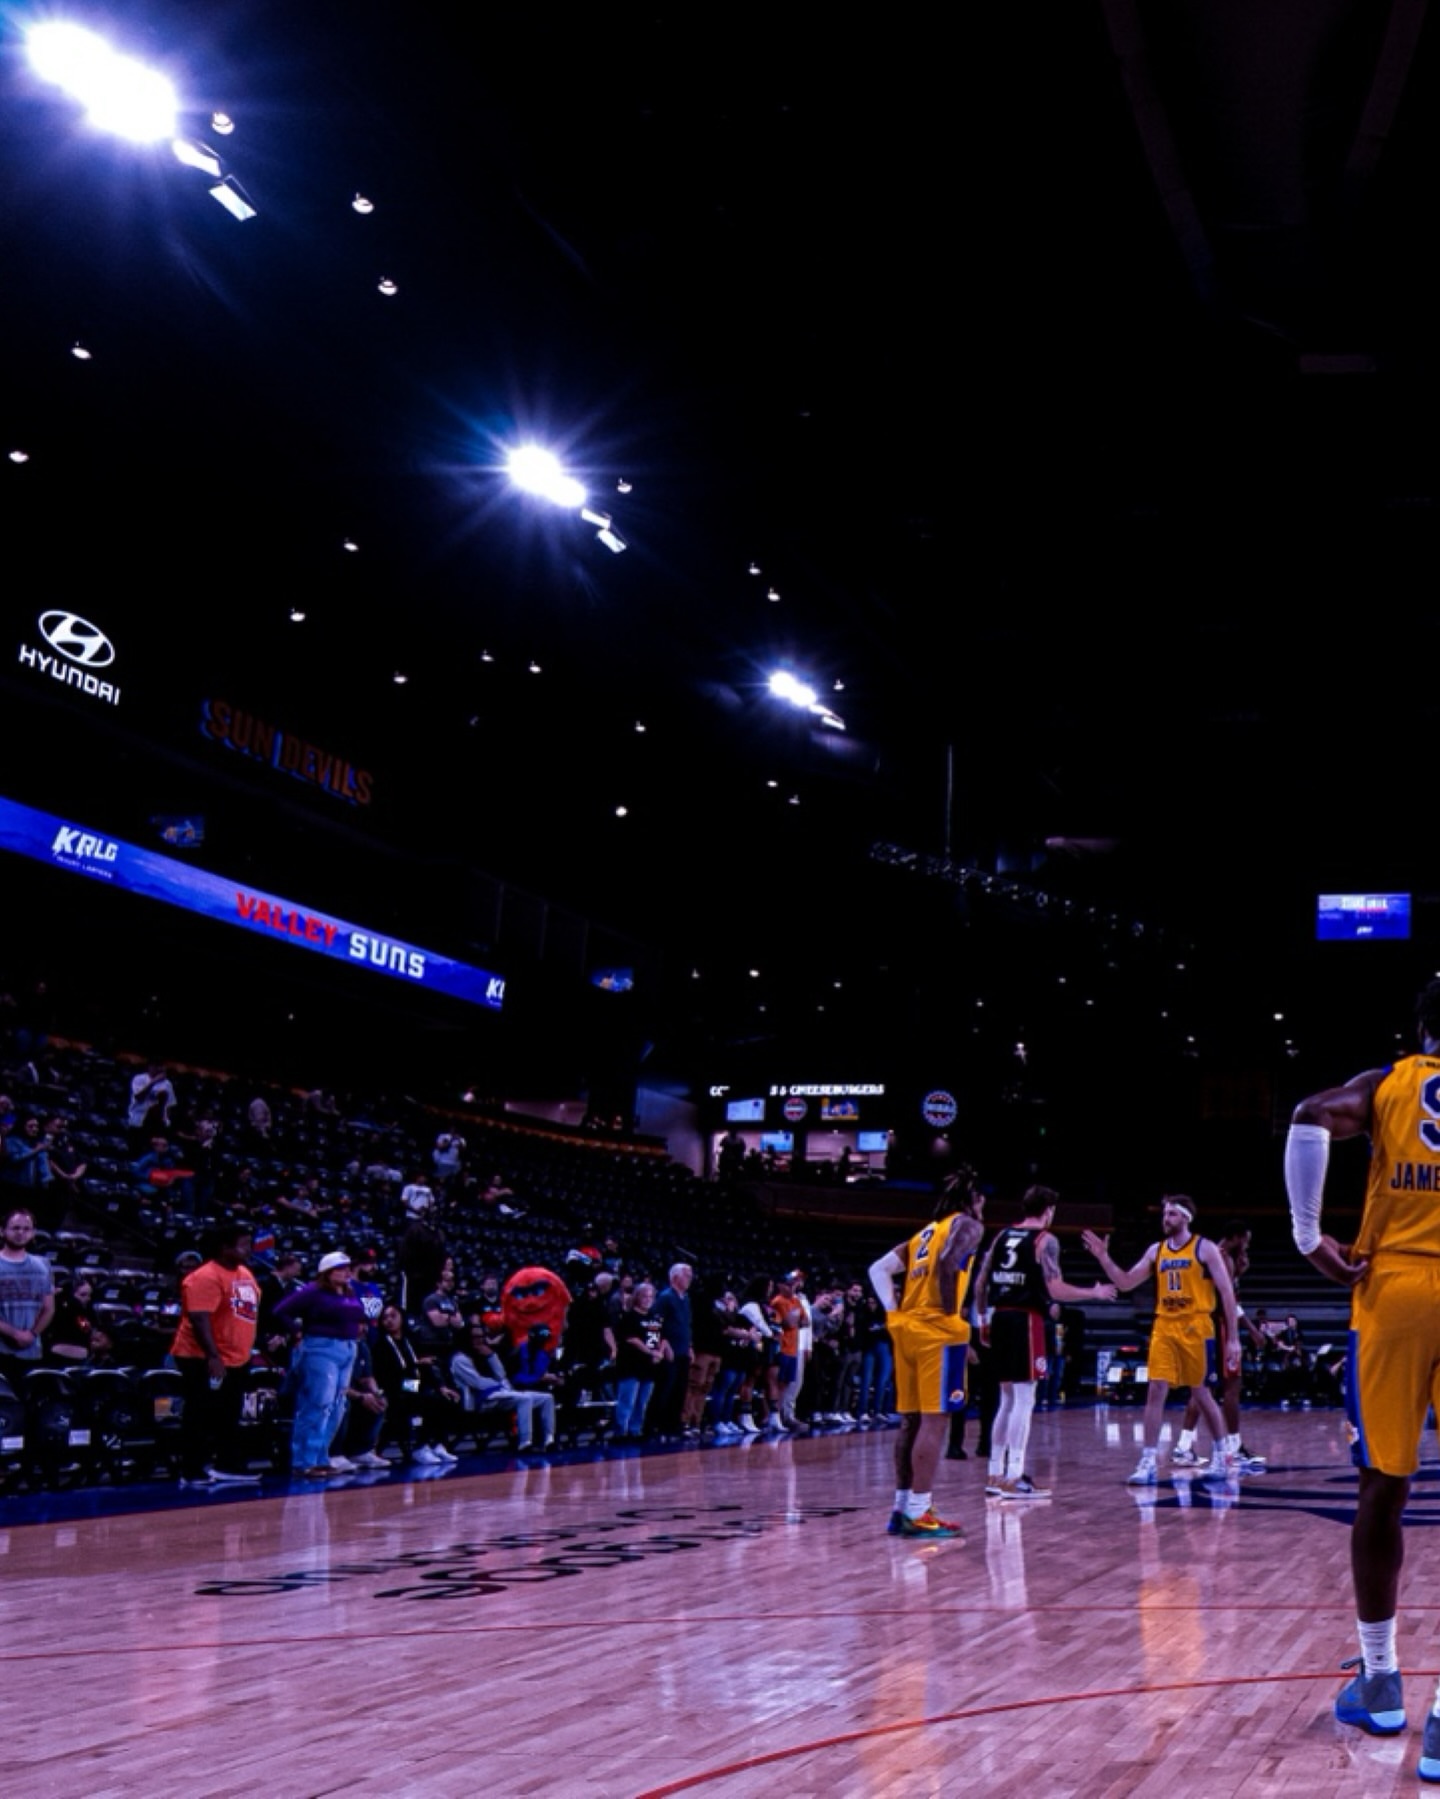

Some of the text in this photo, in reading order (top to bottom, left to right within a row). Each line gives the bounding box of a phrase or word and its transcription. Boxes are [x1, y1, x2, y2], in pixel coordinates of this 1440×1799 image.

[18, 643, 121, 706] HYUNDAI
[201, 699, 374, 805] SUN DEVILS
[52, 825, 119, 862] KRLG
[236, 892, 426, 979] VALLEY SUNS
[1000, 1237, 1022, 1269] 3
[1168, 1271, 1182, 1291] 11
